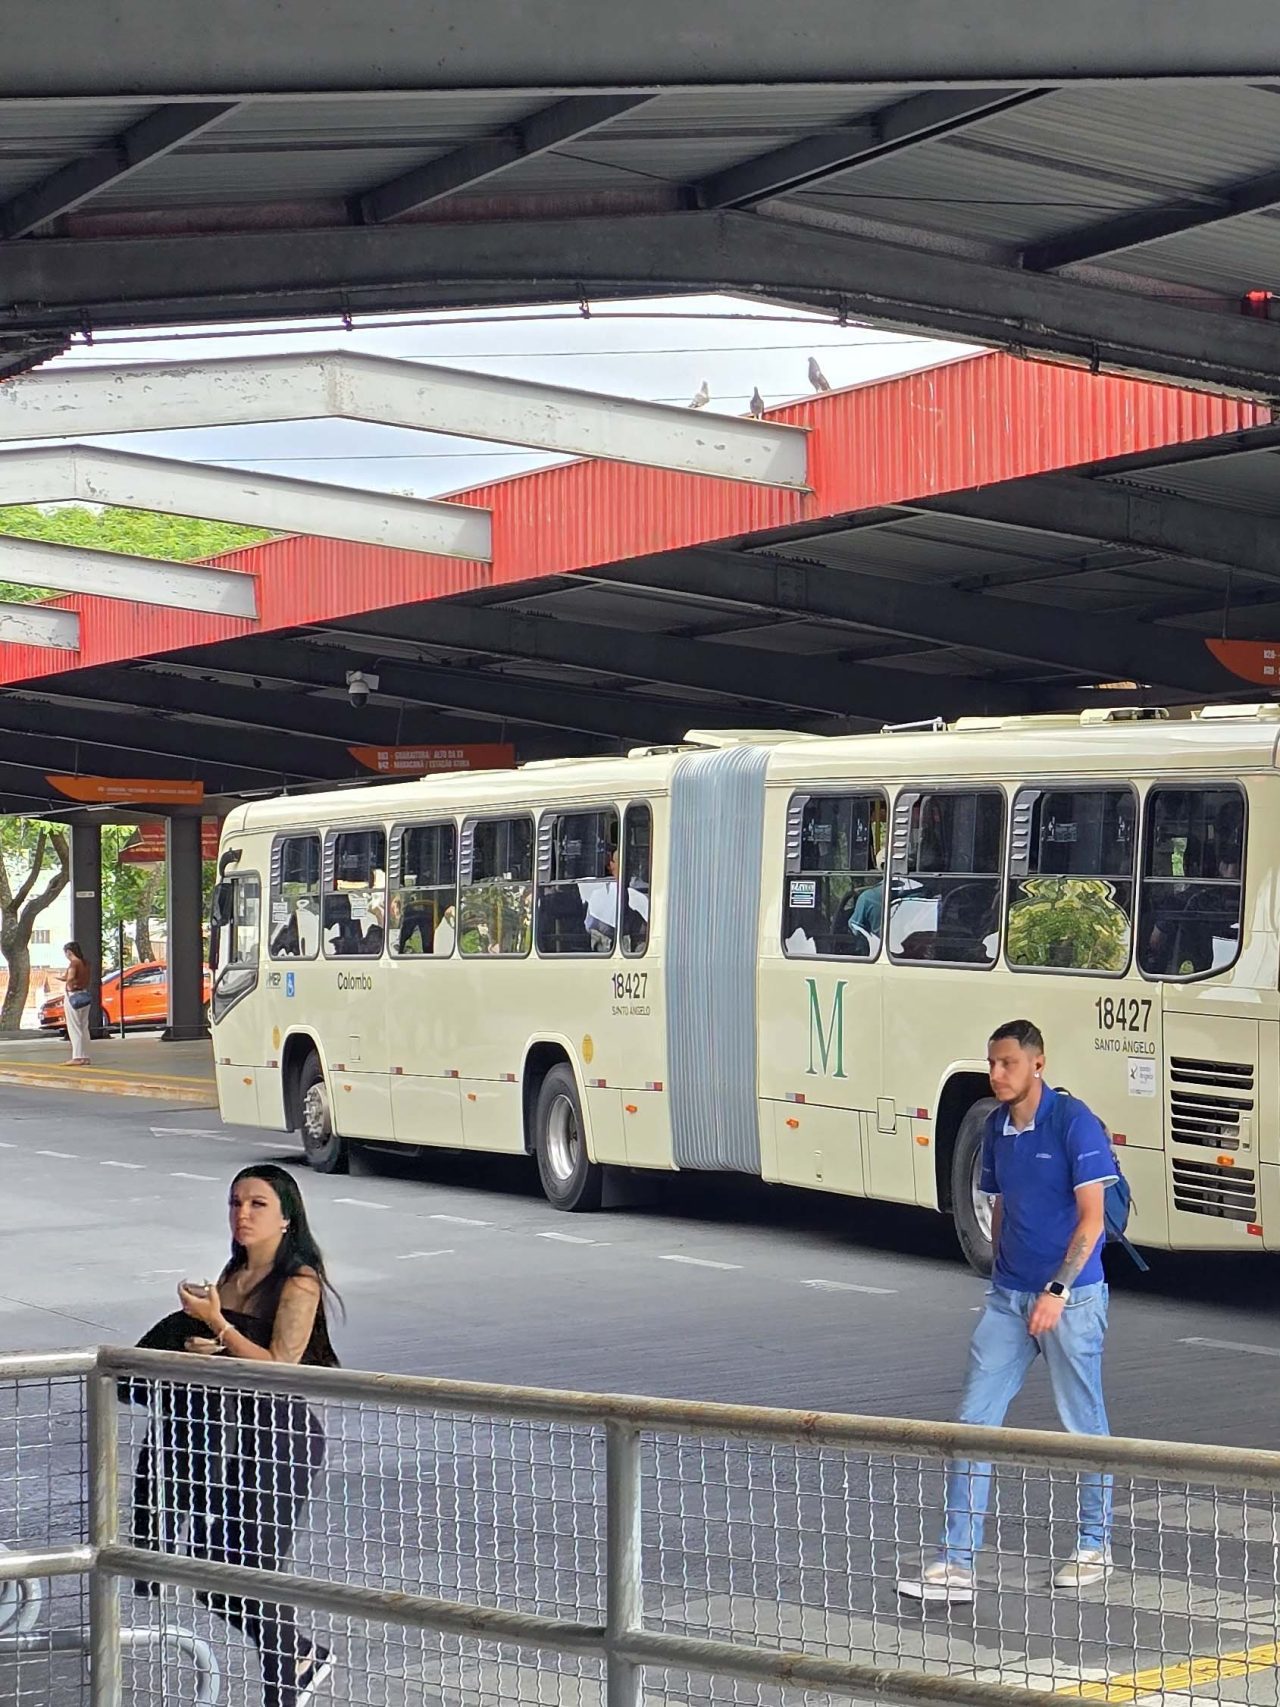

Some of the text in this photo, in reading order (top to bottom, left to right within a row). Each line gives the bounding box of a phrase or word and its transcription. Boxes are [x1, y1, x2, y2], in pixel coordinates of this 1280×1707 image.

[337, 971, 372, 990] Colombo
[611, 972, 648, 999] 18427
[1095, 996, 1152, 1033] 18427
[805, 978, 848, 1079] M
[1094, 1037, 1121, 1052] SANTO
